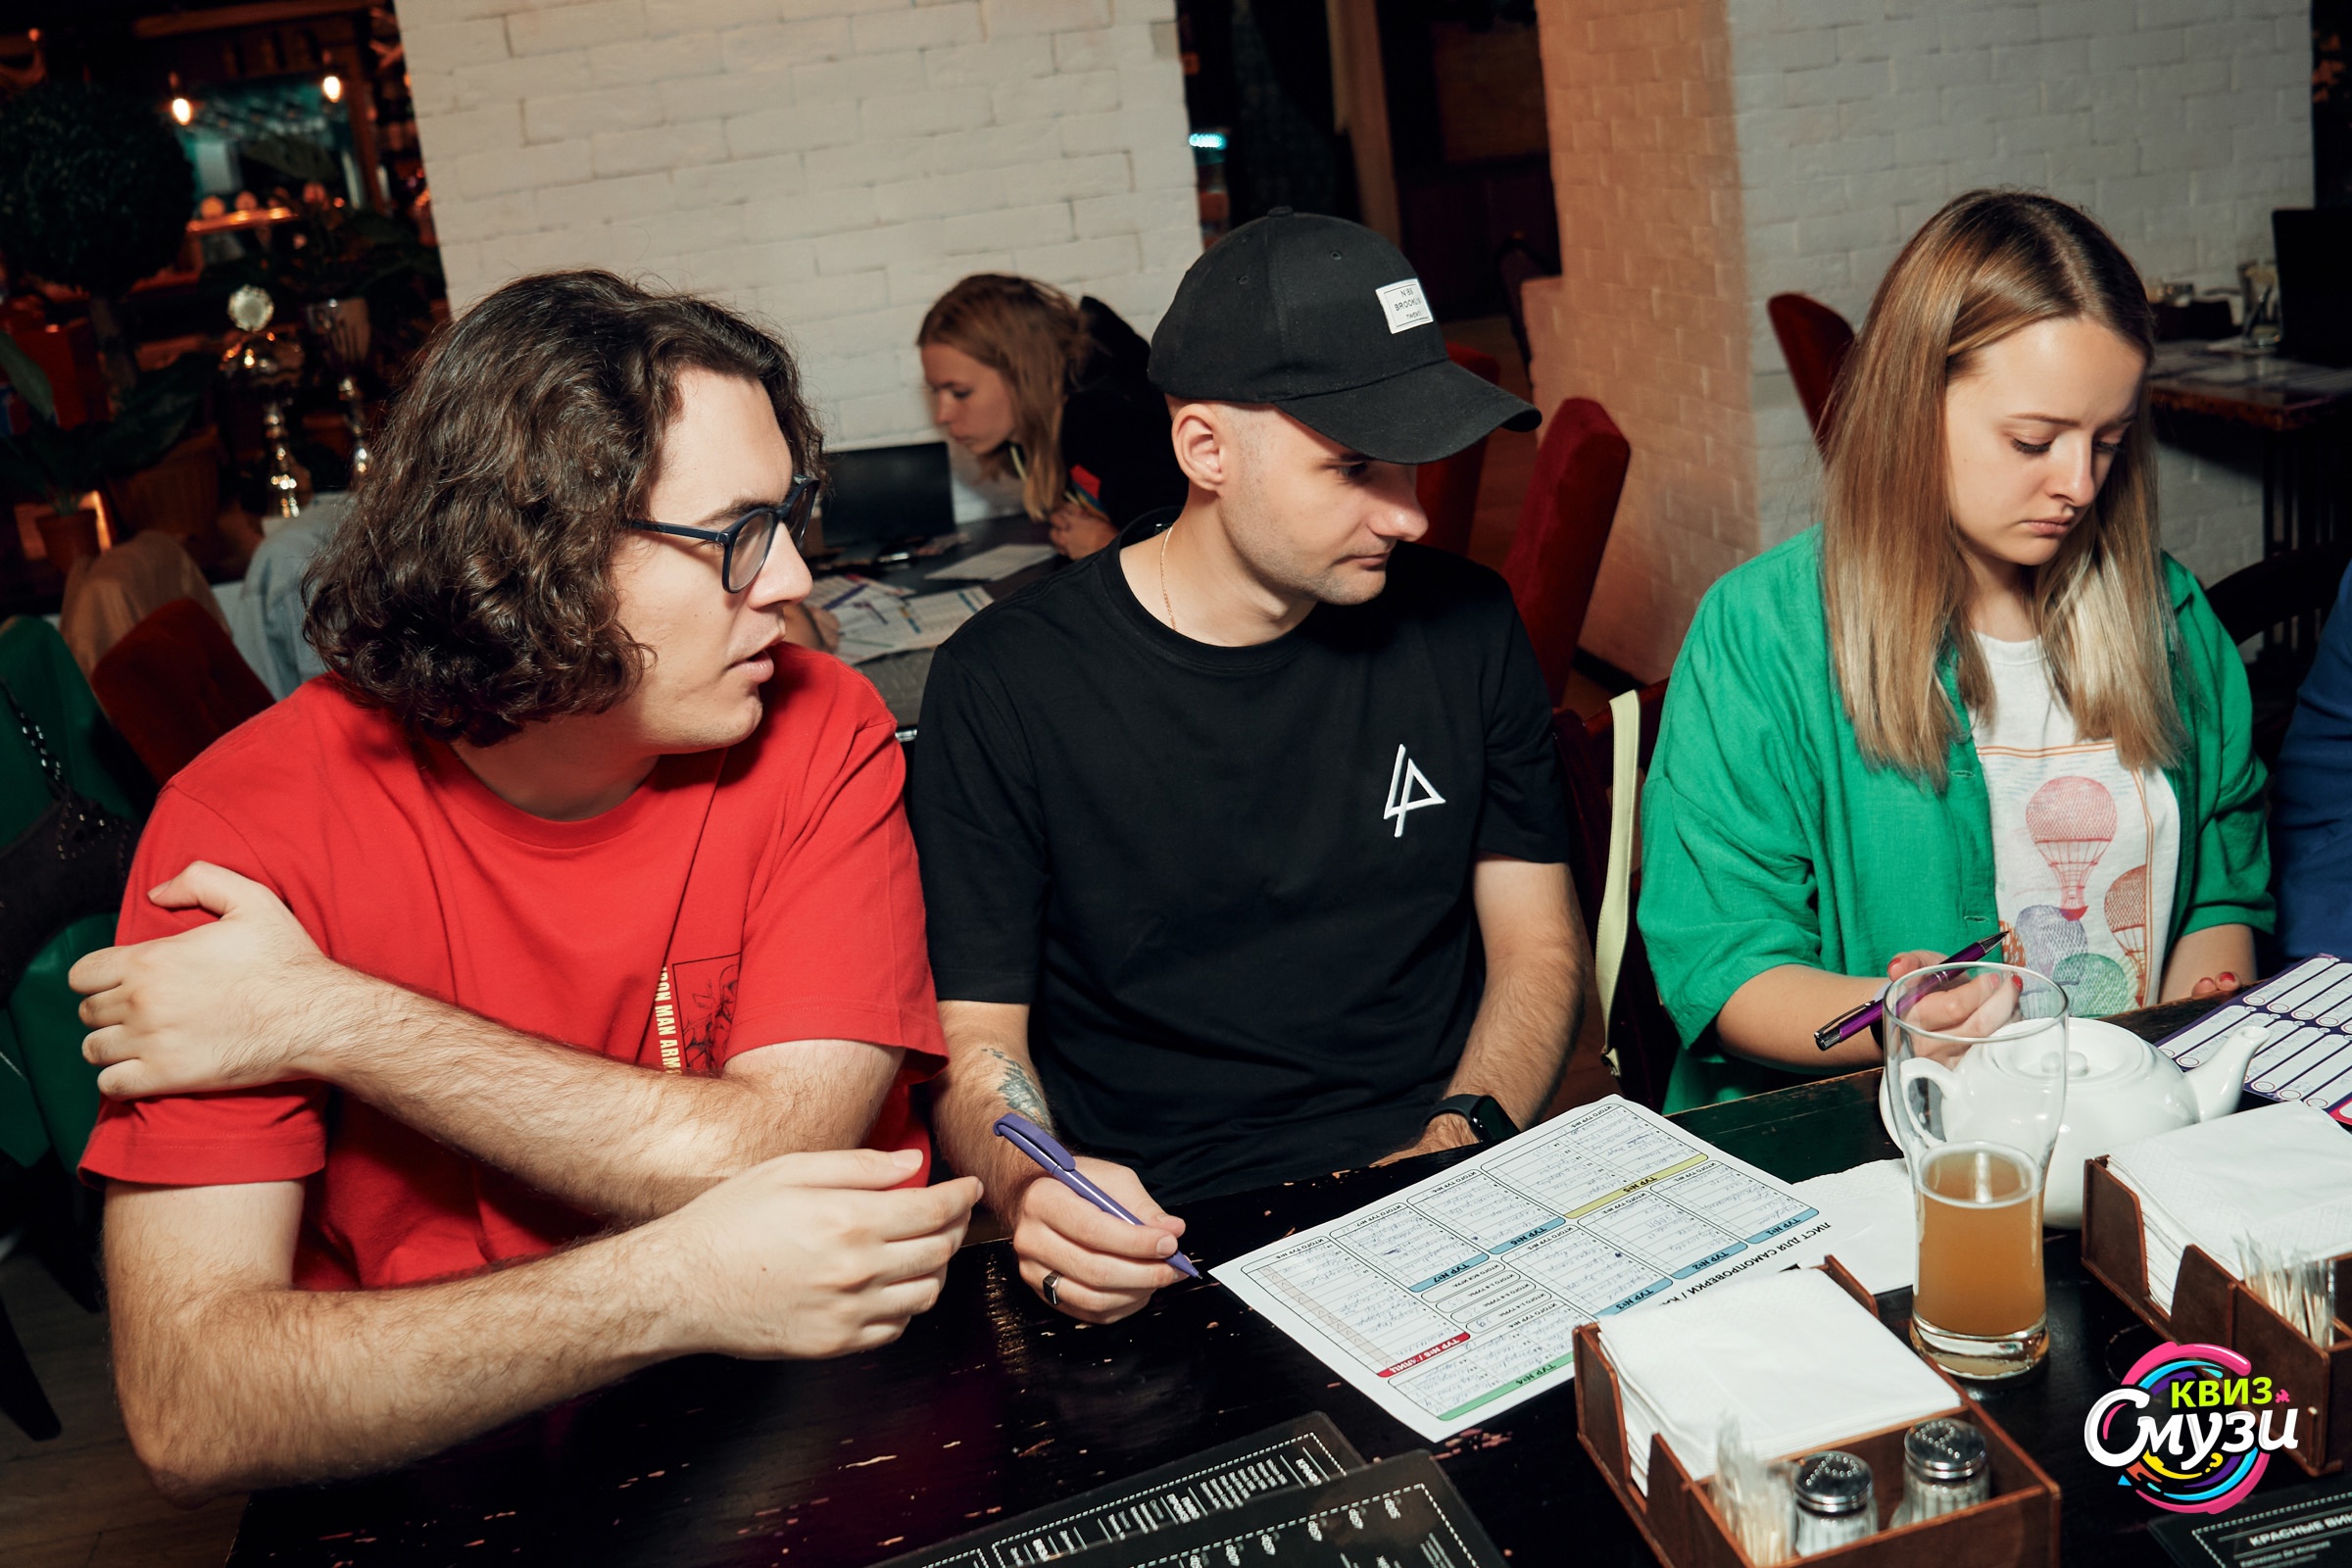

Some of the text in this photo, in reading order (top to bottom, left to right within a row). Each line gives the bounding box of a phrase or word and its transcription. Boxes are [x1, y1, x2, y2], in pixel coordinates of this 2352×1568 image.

[655, 1004, 676, 1036] MAN
[660, 1039, 682, 1074] ARM
[1621, 1175, 1657, 1193] ТУР №5
[1508, 1226, 1546, 1245] ТУР №6
[1764, 1217, 1800, 1235] ТУР №1
[1798, 1222, 1833, 1239] ЛИСТ
[1775, 1237, 1802, 1250] ДЛЯ
[1690, 1250, 1729, 1269] ТУР №2
[1430, 1263, 1470, 1282] ТУР №7
[1686, 1249, 1779, 1294] САМОПРОВЕРКИ
[1614, 1288, 1654, 1309] ТУР №3
[1439, 1338, 1459, 1348] ТУР
[1514, 1362, 1556, 1385] ТУР №4
[2248, 1520, 2325, 1546] КРАСНЫЕ
